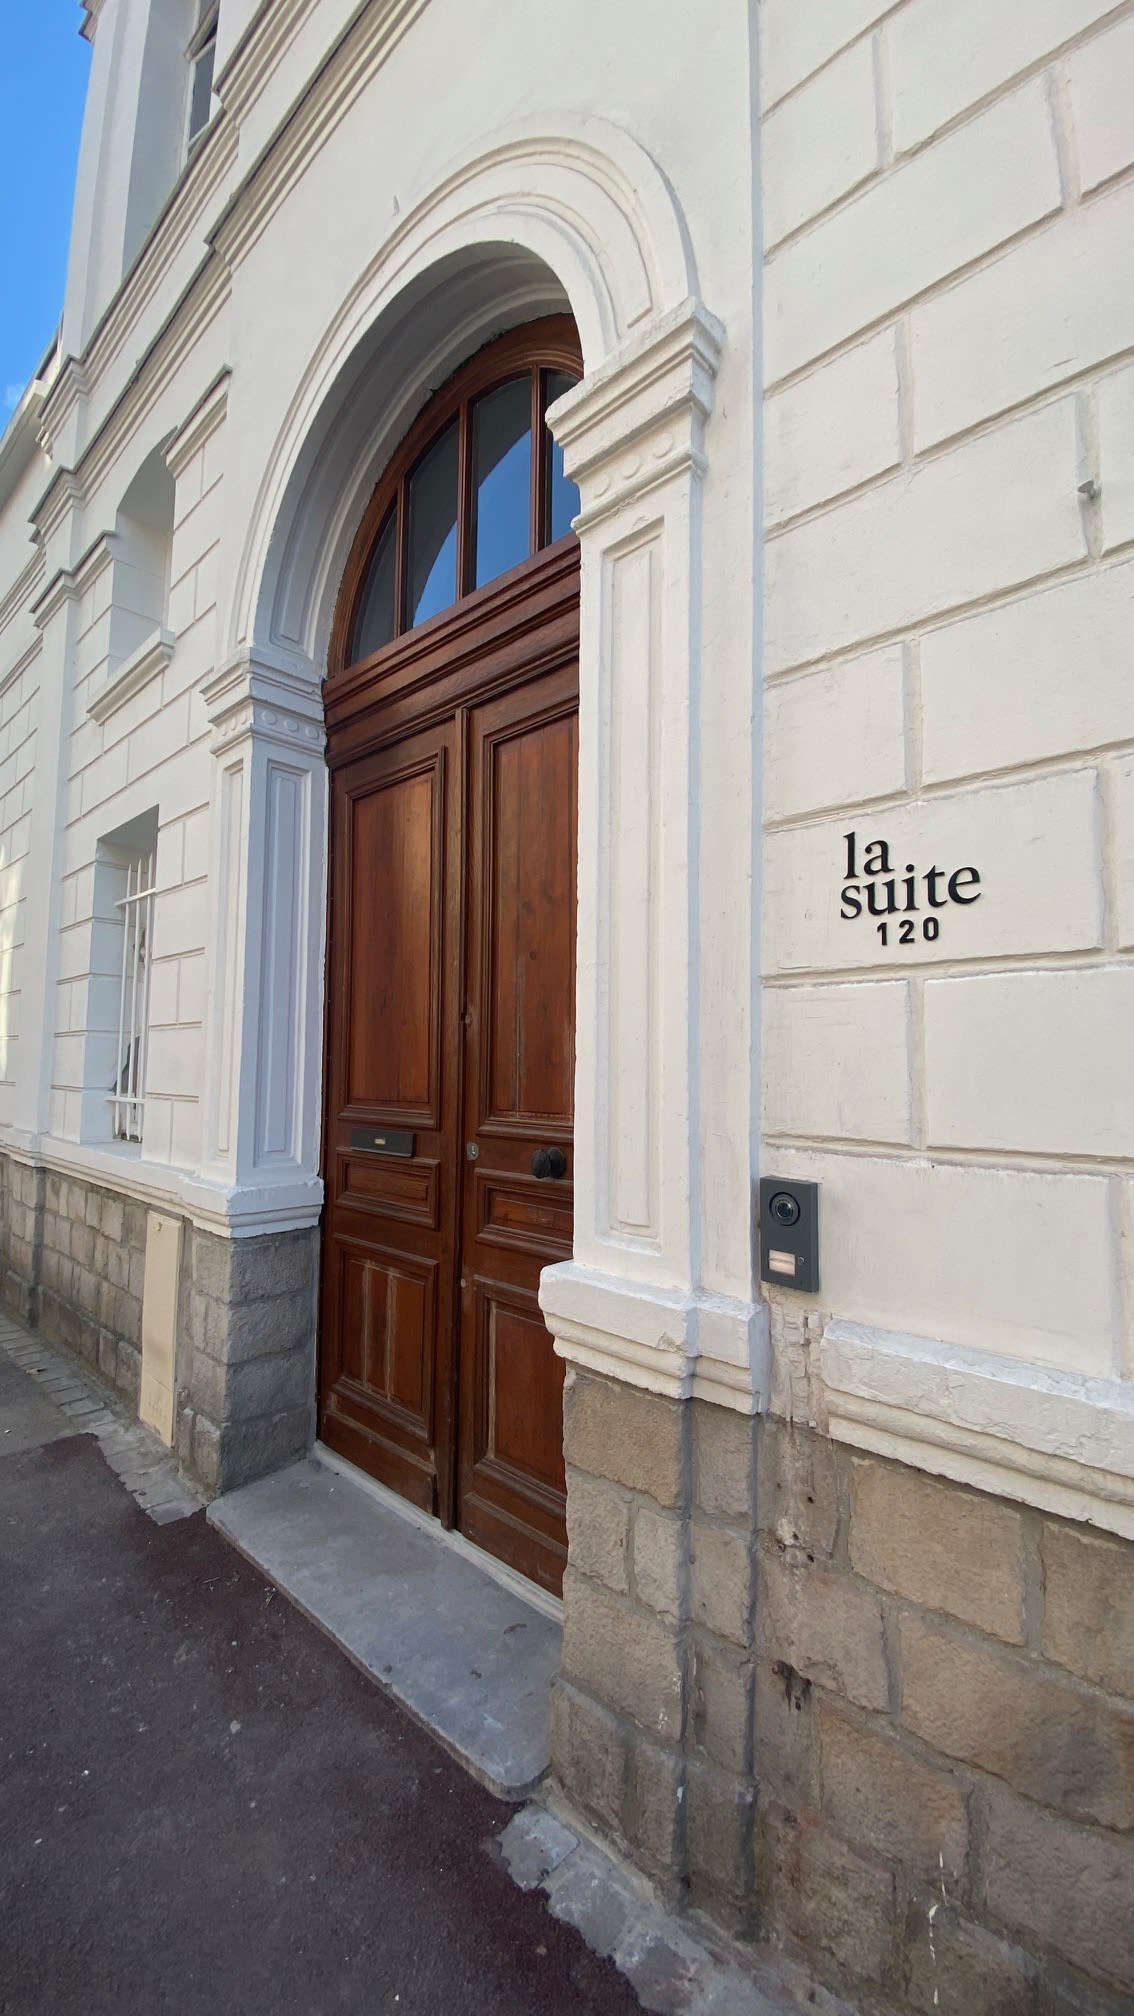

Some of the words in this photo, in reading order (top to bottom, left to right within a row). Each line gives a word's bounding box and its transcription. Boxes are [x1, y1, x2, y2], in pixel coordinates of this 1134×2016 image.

[843, 831, 895, 879] la
[840, 864, 982, 919] suite
[876, 916, 939, 946] 120
